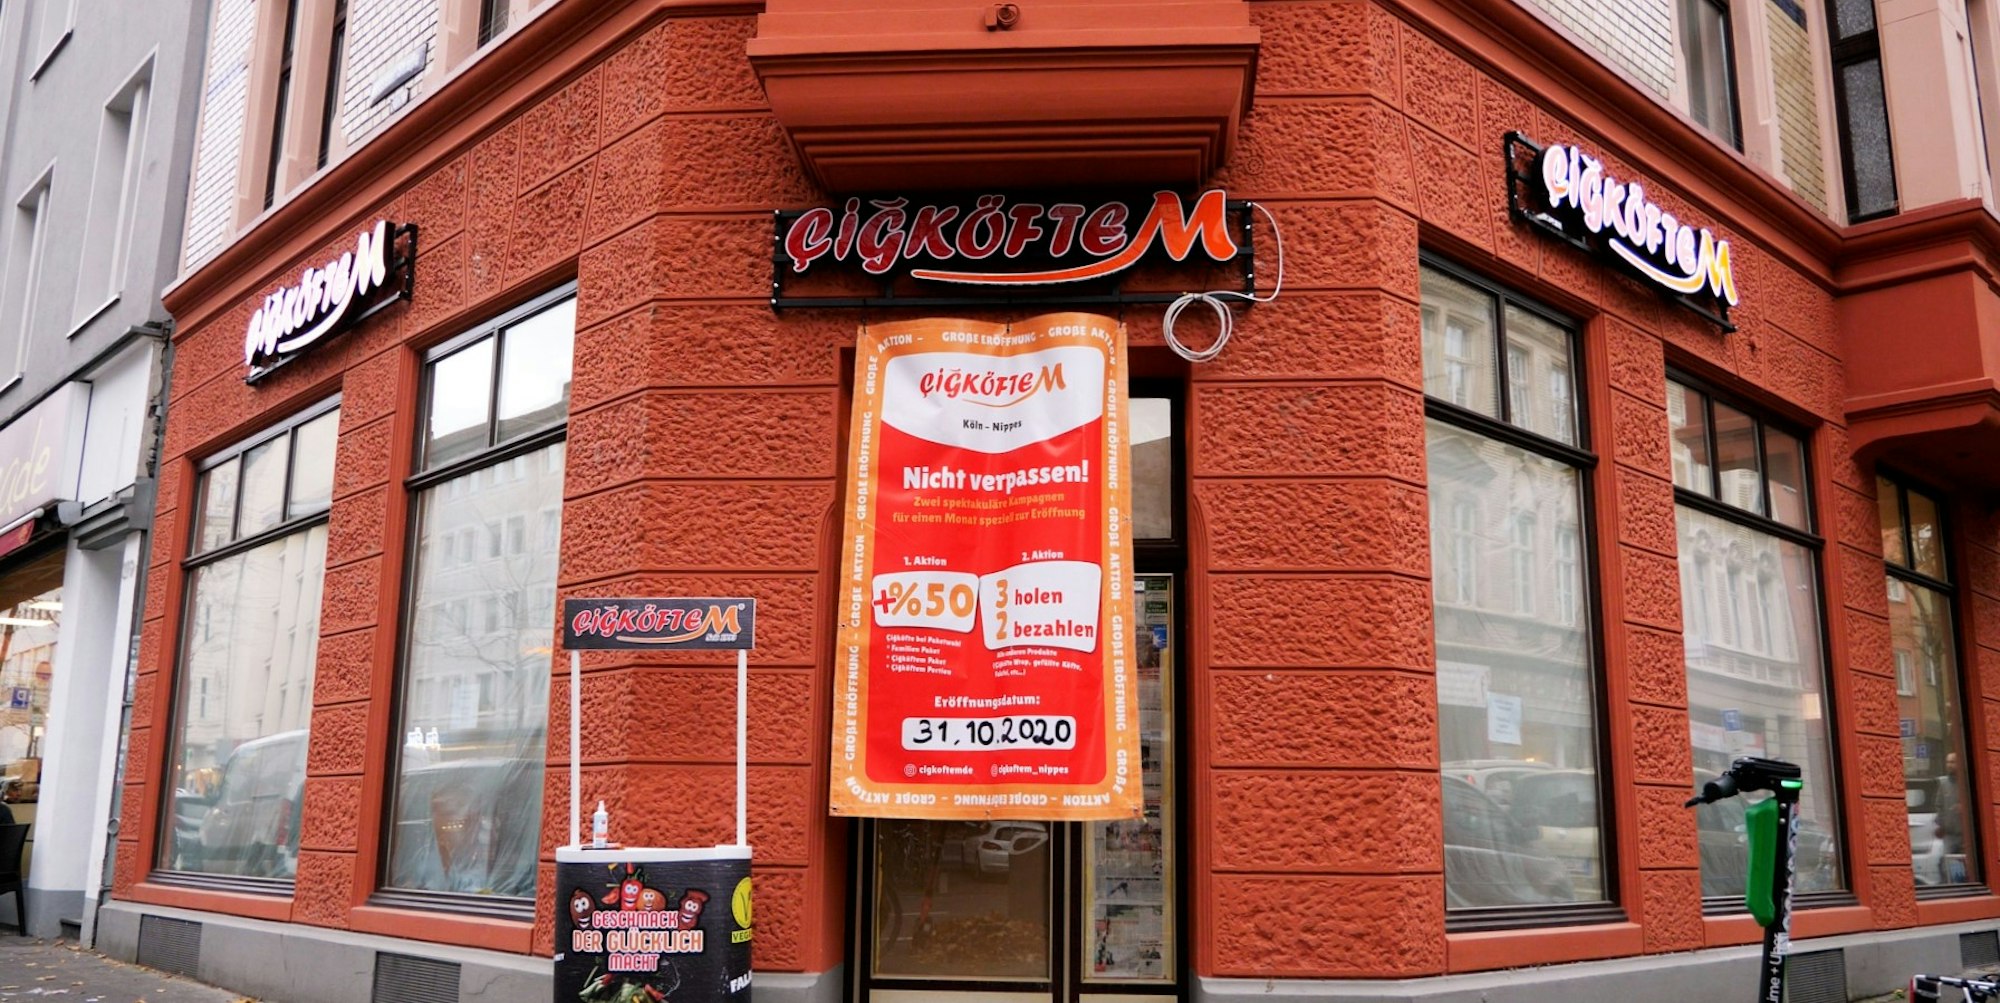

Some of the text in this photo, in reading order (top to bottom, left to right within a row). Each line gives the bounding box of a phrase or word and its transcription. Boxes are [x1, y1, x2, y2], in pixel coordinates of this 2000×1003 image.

[877, 334, 912, 353] AKTION
[981, 331, 1036, 346] ERÖFFNUNG
[963, 419, 982, 430] Köln
[992, 420, 1022, 433] Nippes
[903, 460, 1088, 494] Nicht verpassen!
[914, 492, 1064, 510] Zwei spektakuläre Kampagnen
[893, 511, 910, 522] für
[911, 512, 942, 523] einen
[944, 513, 977, 525] Monat
[1014, 511, 1030, 521] zur
[1031, 507, 1086, 520] Eröffnung
[853, 535, 865, 580] AKTION
[904, 556, 947, 566] 1. Aktion
[1022, 550, 1064, 561] 2. Aktion
[1110, 553, 1121, 600] AKTION
[996, 580, 1062, 609] 3 holen
[996, 611, 1094, 640] 2 bezahlen
[934, 695, 1040, 710] Eröffnungsdatum:
[919, 764, 973, 775] cigkoftemde
[592, 910, 679, 929] GESCHMACK
[572, 926, 704, 953] DER GLÜCKLICH
[732, 929, 752, 943] VEG
[608, 953, 660, 972] MACHT
[1766, 977, 1780, 1003] ime
